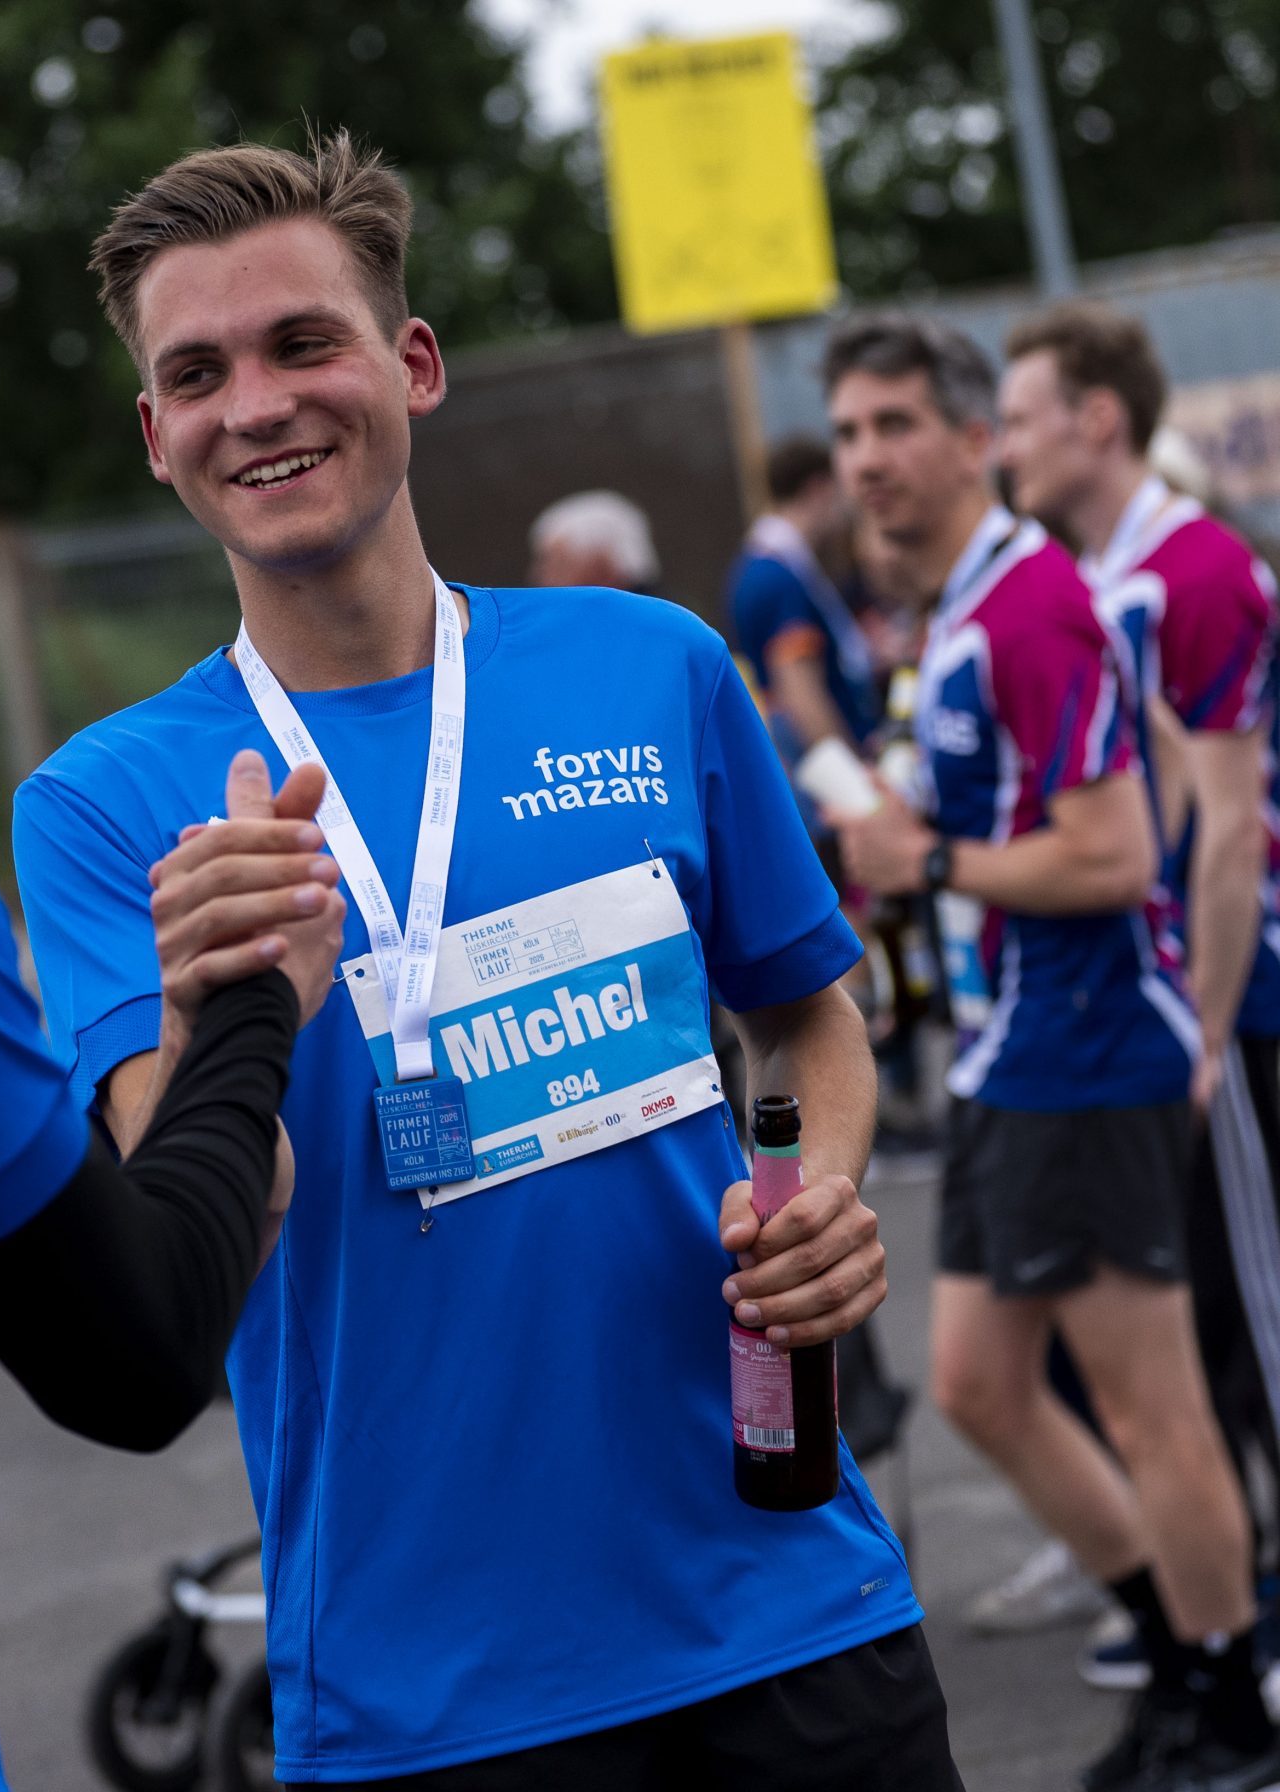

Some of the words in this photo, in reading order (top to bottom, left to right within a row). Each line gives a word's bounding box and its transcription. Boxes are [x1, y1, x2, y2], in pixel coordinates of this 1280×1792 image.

[290, 727, 311, 759] THERME
[441, 758, 452, 780] LAUF
[533, 745, 663, 783] forvis
[431, 786, 443, 825] THERME
[501, 776, 669, 820] mazars
[366, 878, 386, 916] THERME
[378, 924, 392, 948] LAUF
[460, 918, 516, 944] THERME
[465, 929, 520, 954] EUSKIRCHEN
[418, 931, 429, 955] LAUF
[522, 937, 540, 950] KÖLN
[473, 946, 509, 966] FIRMEN
[478, 958, 512, 981] LAUF
[405, 963, 418, 1004] THERME
[439, 962, 649, 1085] Michel
[376, 1089, 432, 1106] THERME
[546, 1068, 601, 1108] 894
[378, 1101, 433, 1115] EUSKIRCHEN
[640, 1096, 669, 1118] DKMS
[386, 1114, 430, 1132] FIRMEN
[388, 1128, 432, 1151] LAUF
[496, 1140, 537, 1159] THERME
[403, 1154, 425, 1167] KÖLN
[498, 1149, 539, 1168] EUSKIRCHEN
[389, 1170, 438, 1187] GEMEINSAM
[439, 1167, 453, 1179] INS
